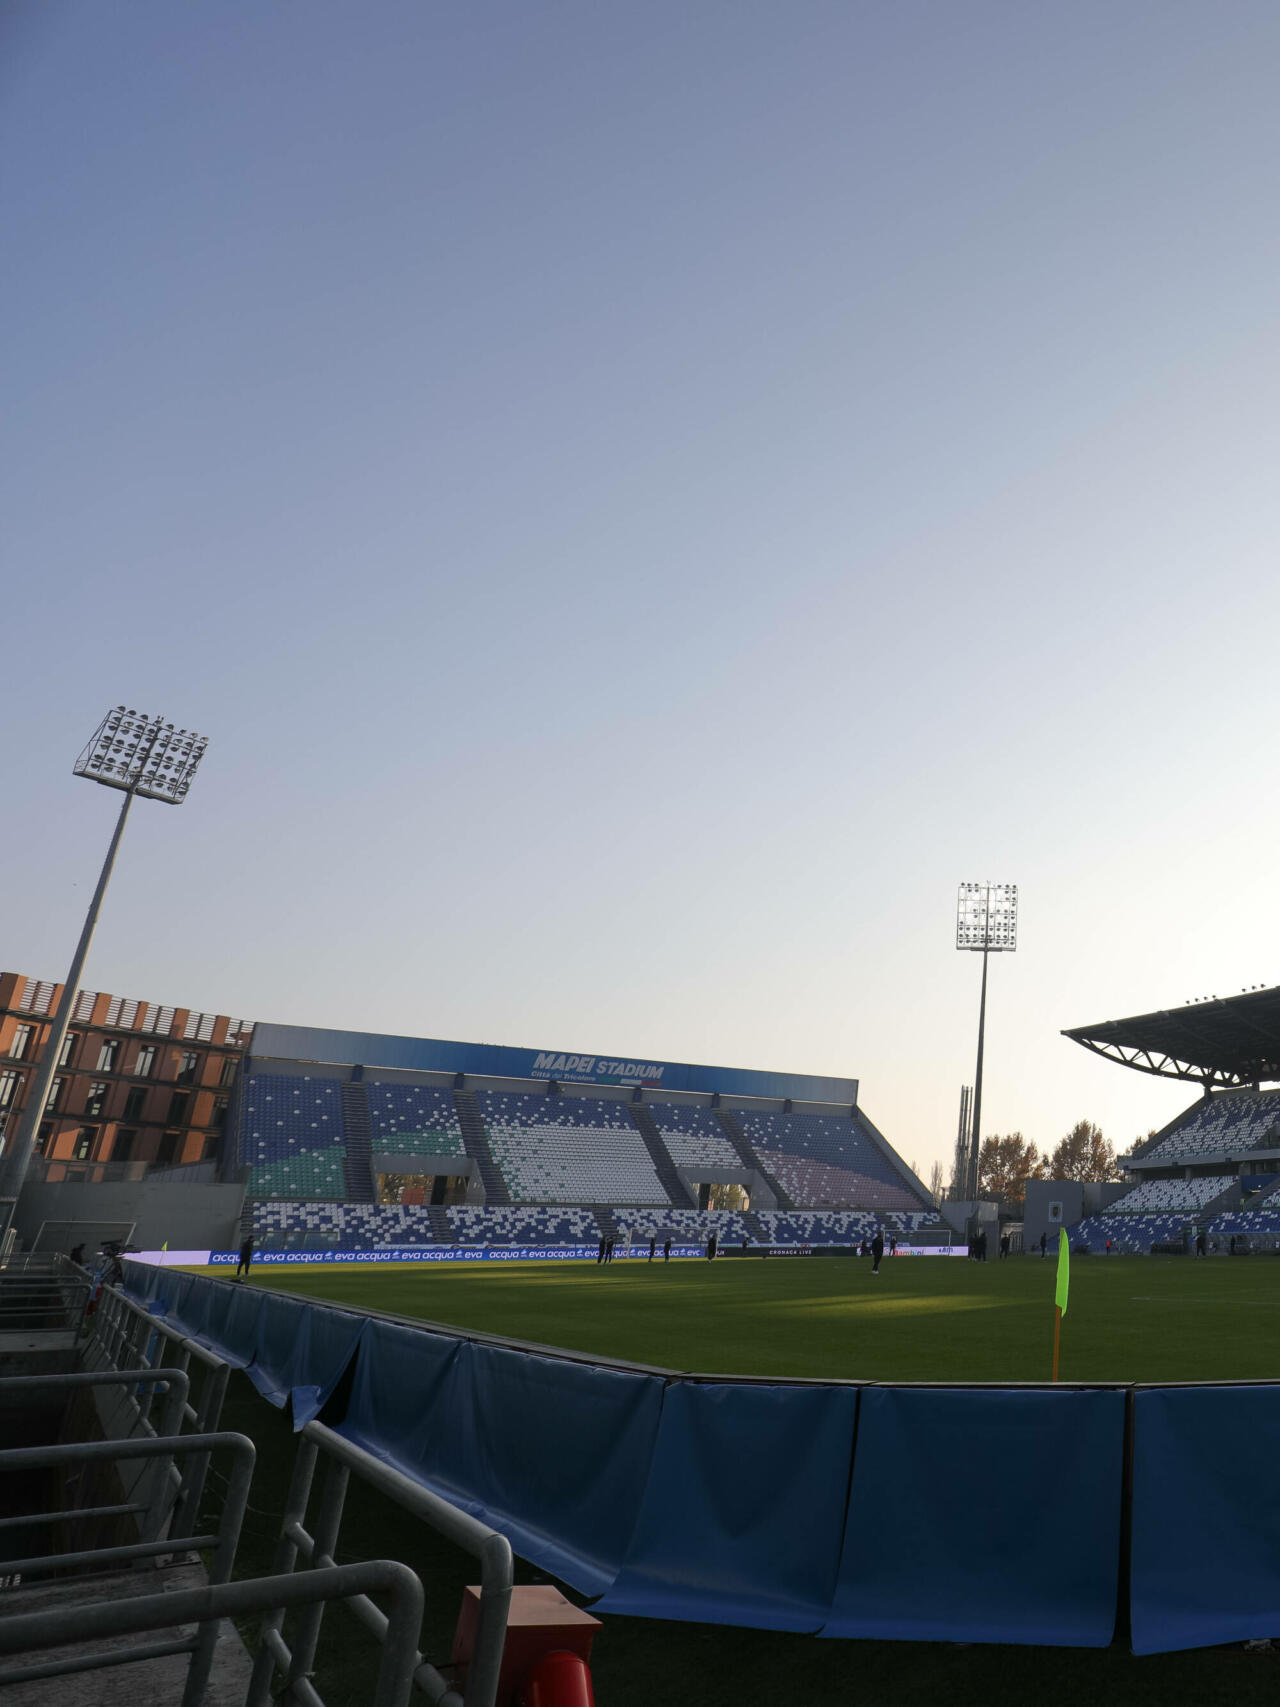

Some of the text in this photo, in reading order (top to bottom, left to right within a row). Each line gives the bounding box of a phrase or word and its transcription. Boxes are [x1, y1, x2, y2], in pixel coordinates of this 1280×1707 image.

[533, 1053, 665, 1079] MAPEI STADIUM
[212, 1254, 241, 1262] acqu
[286, 1253, 323, 1262] acqua
[334, 1253, 355, 1261] eva
[356, 1252, 391, 1261] acqua
[422, 1251, 454, 1261] acqua
[489, 1251, 520, 1260] acqua
[528, 1250, 546, 1258] eva
[547, 1250, 576, 1259] acqua
[653, 1248, 679, 1257] acua
